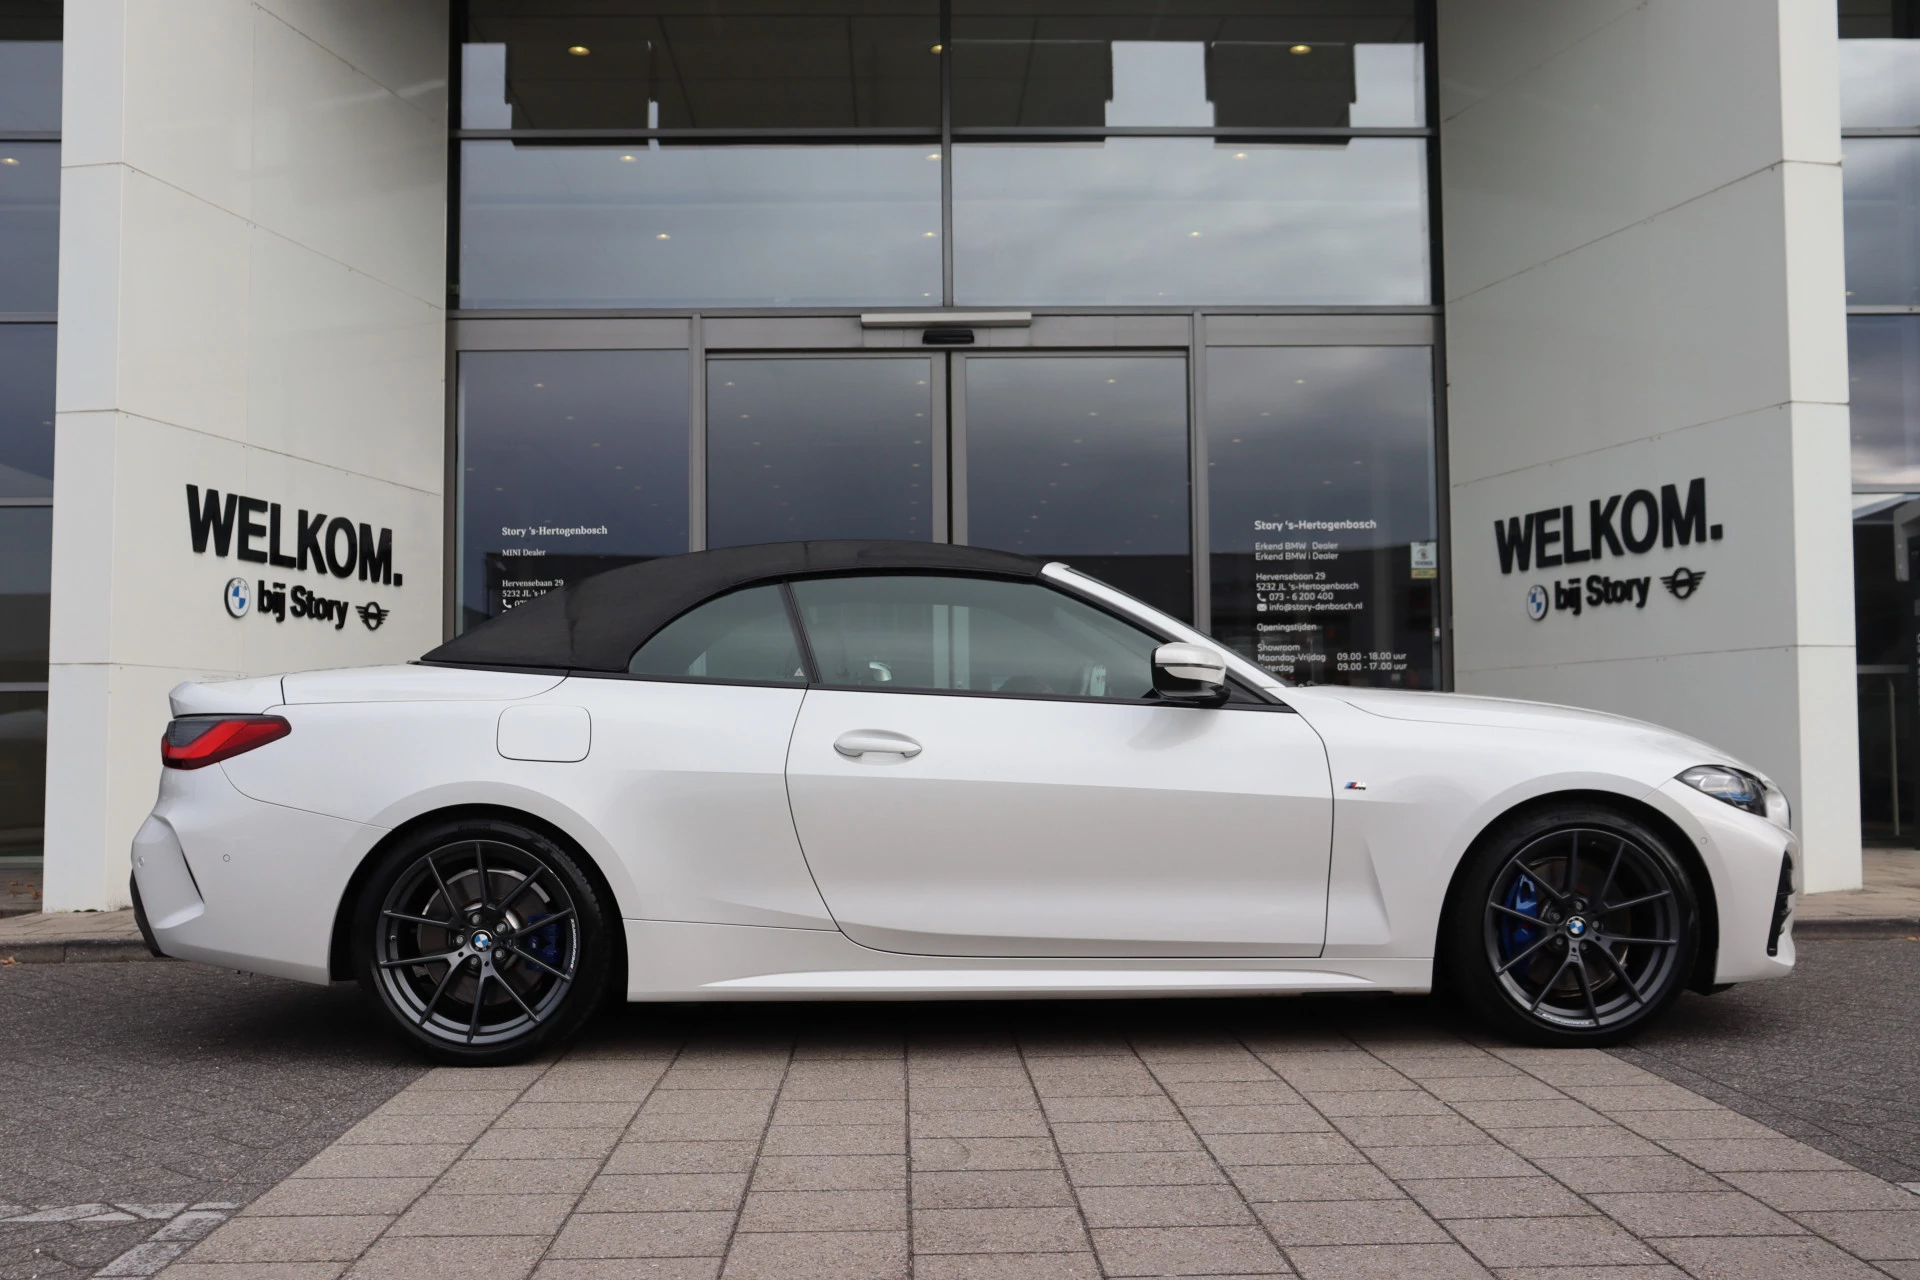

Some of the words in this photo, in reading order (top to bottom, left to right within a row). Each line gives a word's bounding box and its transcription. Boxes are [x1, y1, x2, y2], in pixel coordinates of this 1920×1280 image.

[1254, 520, 1283, 532] Story
[1494, 477, 1723, 575] WELKOM.
[186, 483, 403, 587] WELKOM.
[501, 526, 527, 537] Story
[1255, 542, 1283, 550] Erkend
[1285, 542, 1306, 550] BMW
[1312, 541, 1339, 550] Dealer
[502, 549, 521, 557] MINI
[523, 548, 546, 556] Dealer
[1255, 552, 1283, 561] Erkend
[1285, 552, 1306, 560] BMW
[1312, 551, 1339, 560] Dealer
[1256, 572, 1313, 581] Hervensebaan
[1315, 571, 1326, 580] 29
[502, 579, 553, 588] Hervensebaan
[554, 579, 564, 587] 29
[1256, 582, 1276, 591] 5232
[1278, 582, 1286, 591] JL
[502, 589, 520, 598] 5232
[1586, 574, 1651, 609] Story
[1269, 592, 1284, 601] 073
[1292, 592, 1298, 601] 6
[1299, 592, 1315, 600] 200
[1317, 592, 1334, 600] 400
[290, 584, 349, 630] Story
[1257, 623, 1317, 632] Openingstijden
[1257, 643, 1300, 652] Showroom
[1337, 652, 1361, 661] 09.00
[1369, 652, 1392, 660] 18.00
[1337, 662, 1361, 671] 09.00
